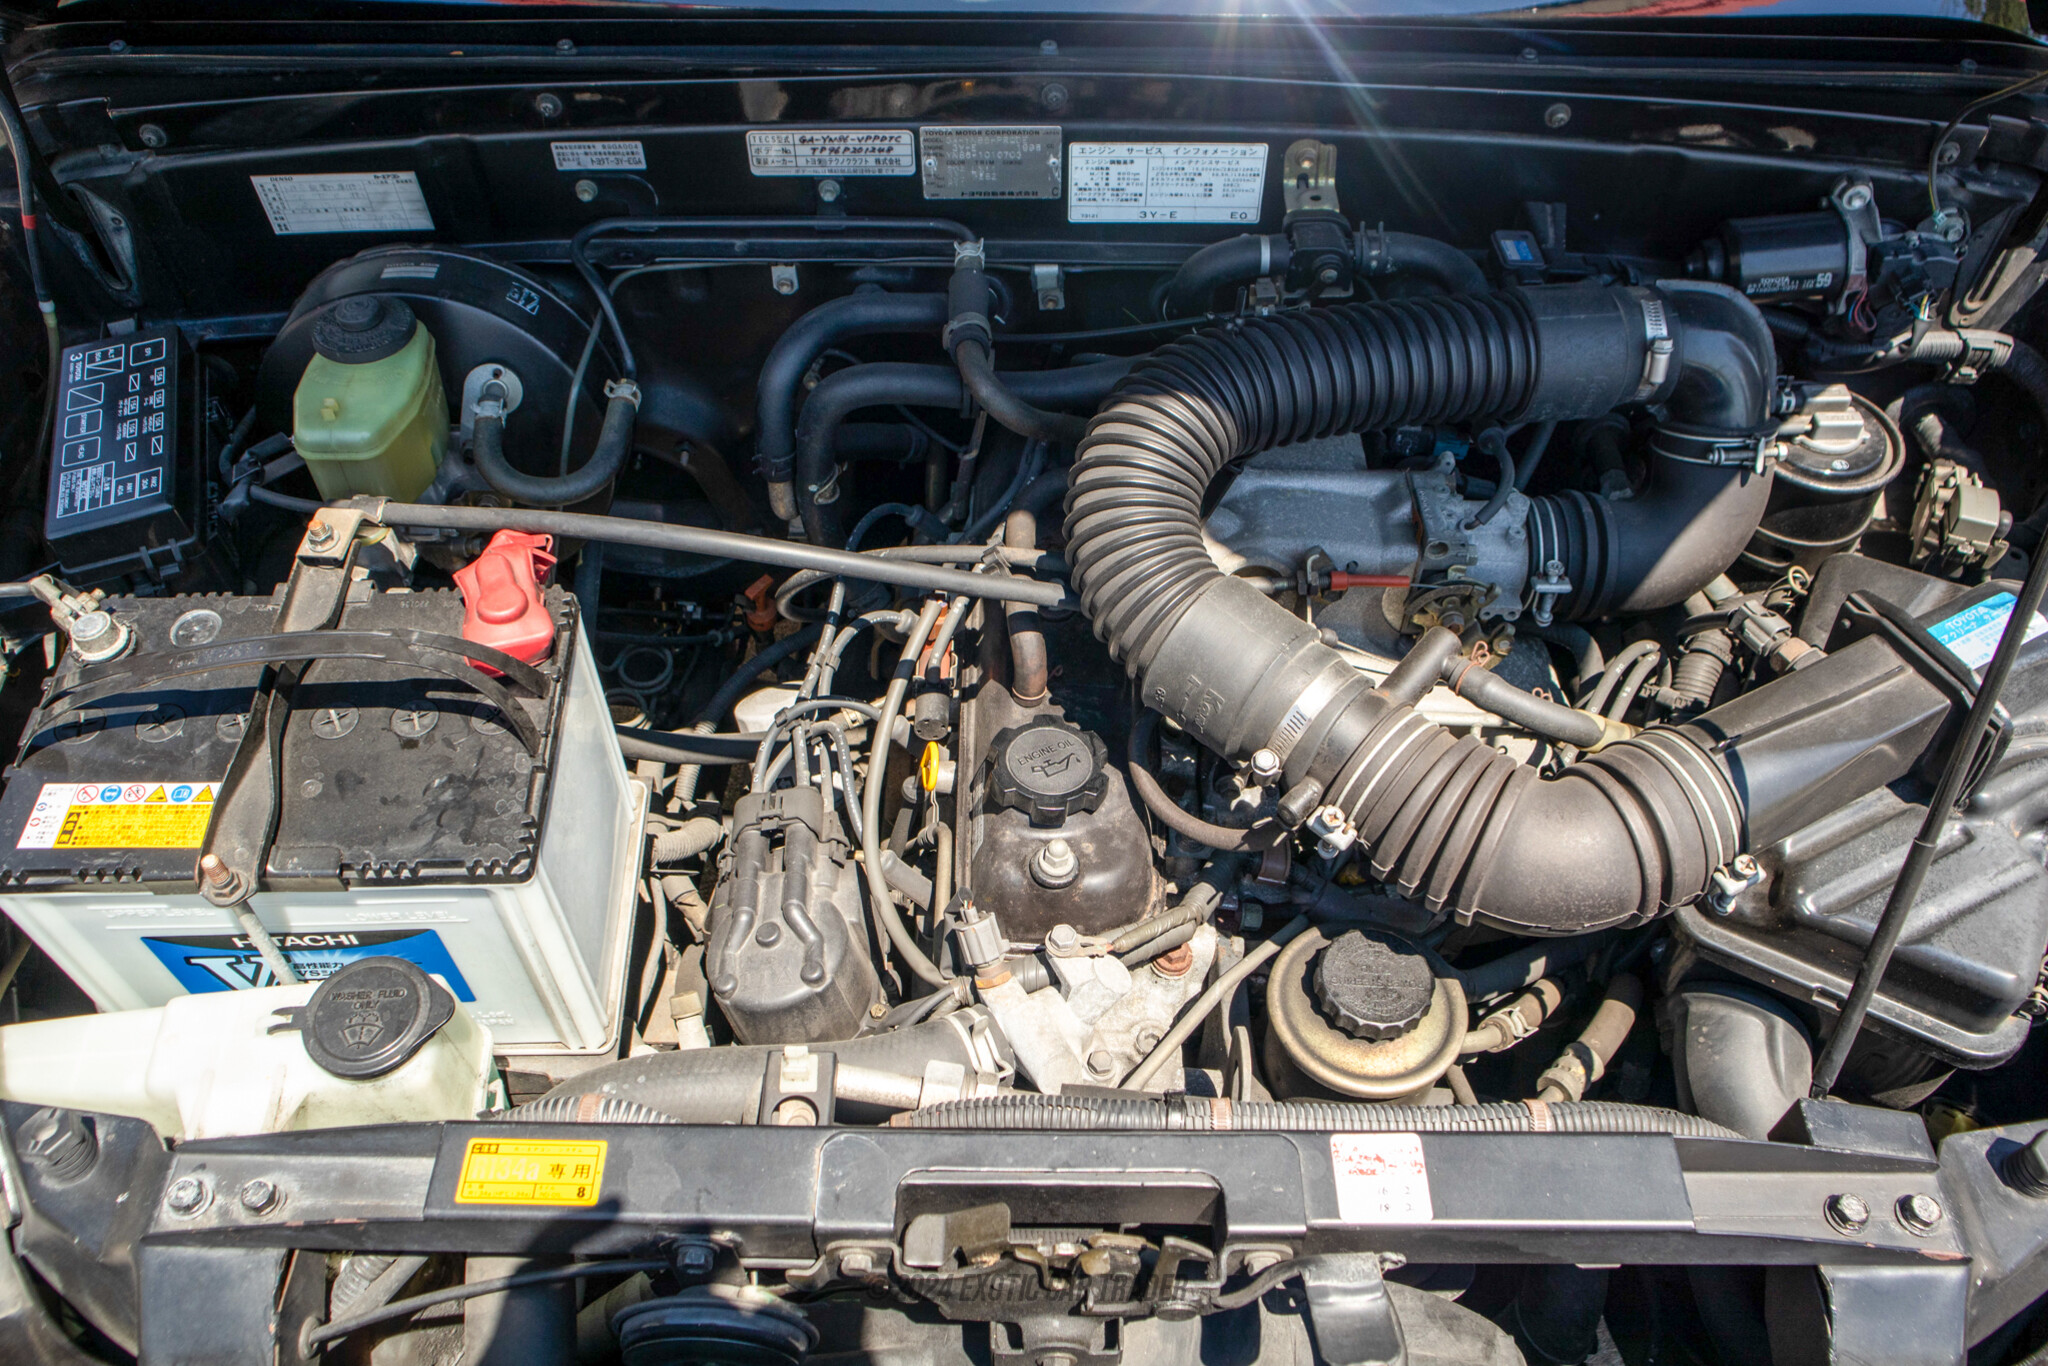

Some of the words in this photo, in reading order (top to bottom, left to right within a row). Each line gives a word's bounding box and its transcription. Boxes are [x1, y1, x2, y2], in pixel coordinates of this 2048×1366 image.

[1173, 148, 1258, 156] インフォメーション
[1052, 187, 1059, 196] C
[1139, 210, 1178, 219] 3Y-E
[1816, 272, 1833, 288] 59
[70, 352, 82, 362] 3
[1945, 606, 1989, 629] TOYOTA
[1017, 744, 1057, 766] ENGINE
[1057, 740, 1076, 750] OIL
[161, 908, 216, 917] LEVEL
[345, 912, 402, 921] LOWER
[405, 910, 457, 920] LEVEL
[232, 934, 360, 948] HTACHI
[331, 990, 373, 1000] WASHER
[378, 989, 406, 999] FLUID
[353, 1000, 380, 1010] ONLY
[472, 1156, 541, 1181] R134a
[576, 1186, 586, 1198] 8
